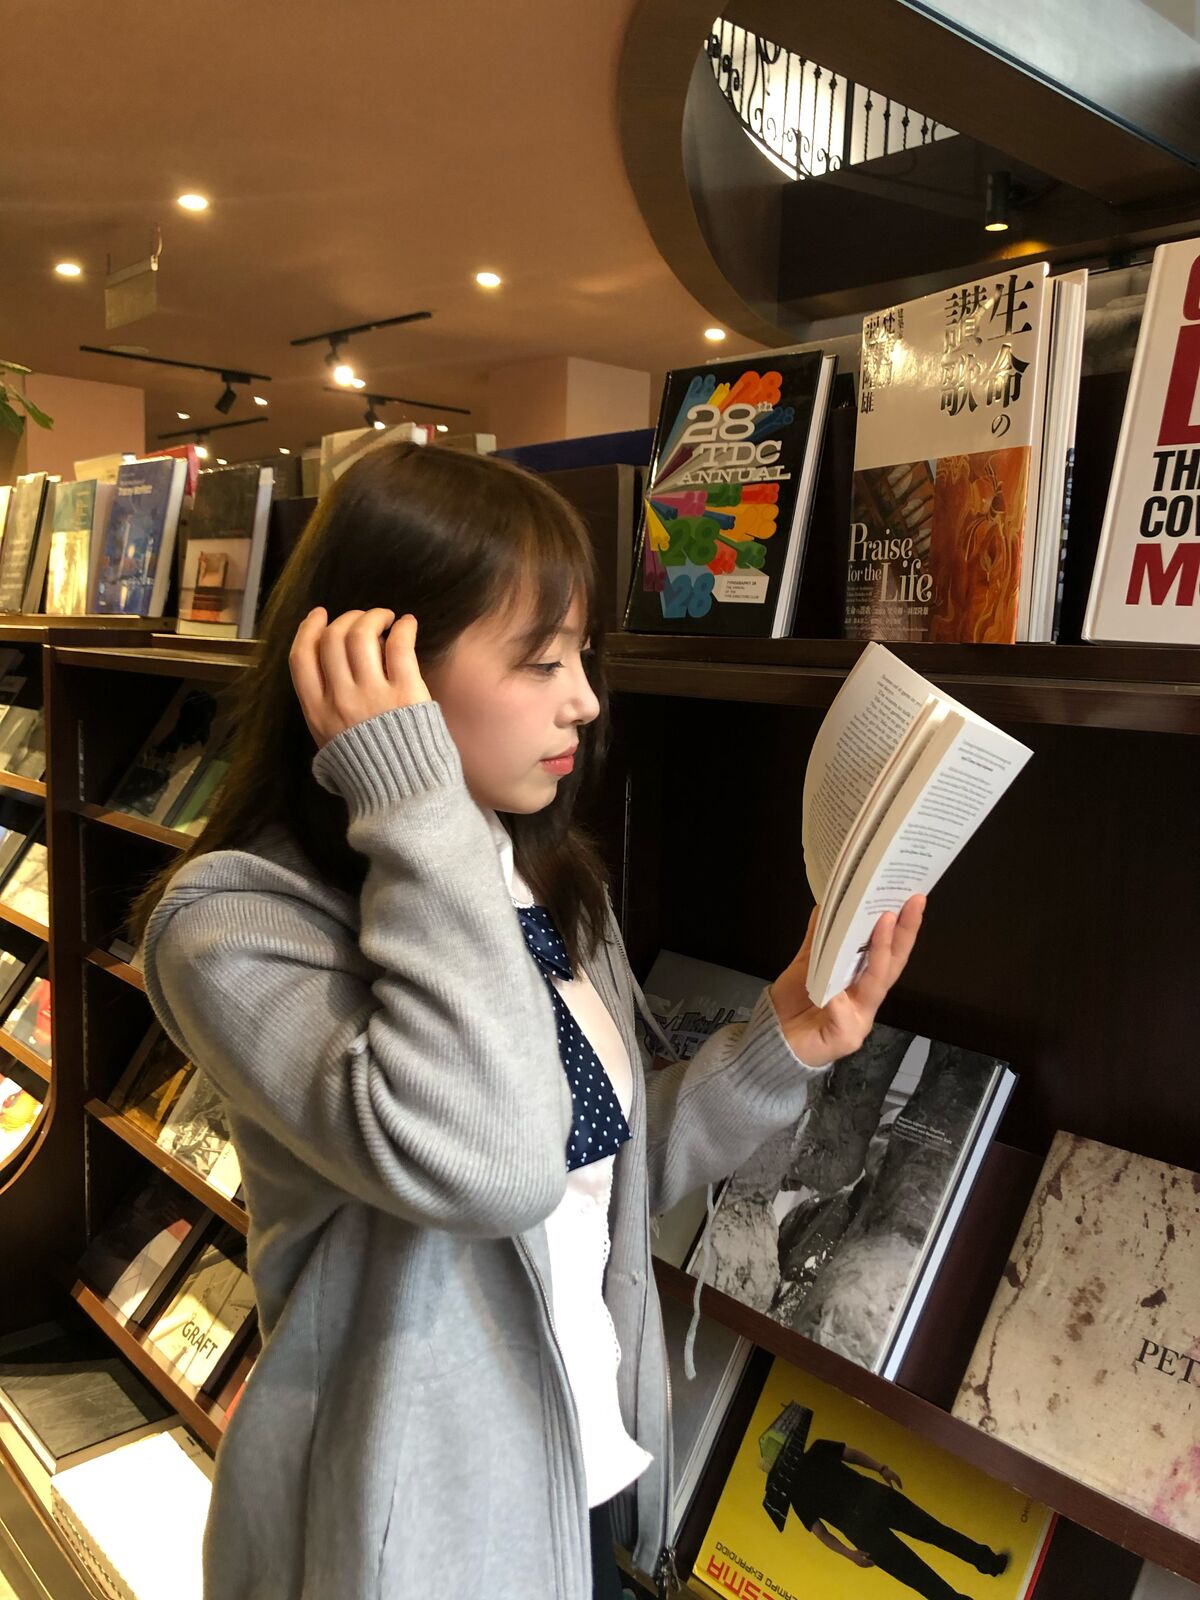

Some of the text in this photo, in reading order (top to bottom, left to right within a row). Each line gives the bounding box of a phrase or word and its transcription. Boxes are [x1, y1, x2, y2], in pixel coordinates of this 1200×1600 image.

[694, 440, 783, 468] TDC
[678, 465, 791, 486] ANNUAL
[1140, 495, 1200, 538] CO
[660, 517, 720, 567] 28
[848, 522, 913, 562] Praise
[663, 572, 715, 618] 28
[847, 563, 864, 582] for
[864, 563, 882, 582] the
[879, 558, 933, 602] Life
[182, 1320, 218, 1360] GRAFT
[715, 1541, 764, 1582] EXPANDIDO
